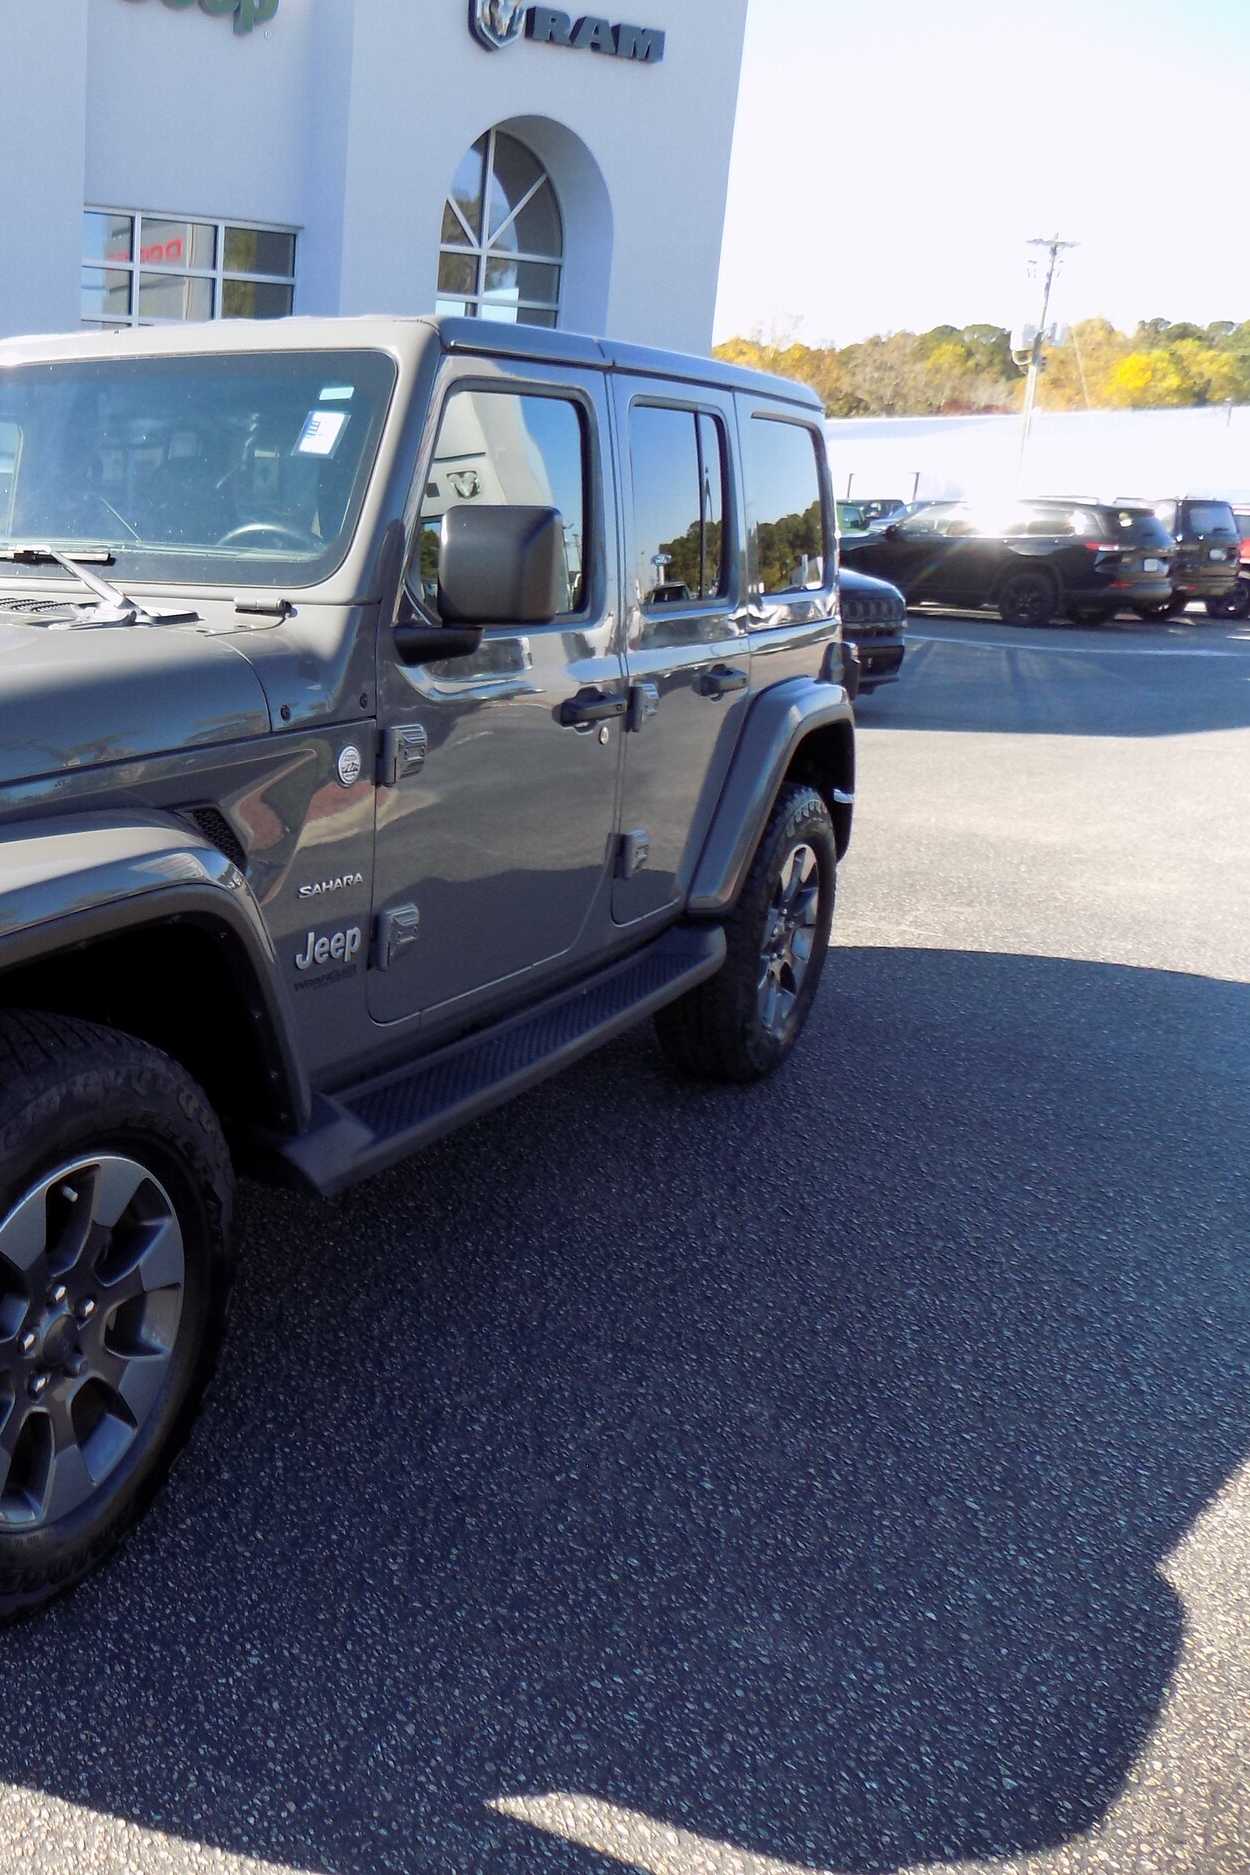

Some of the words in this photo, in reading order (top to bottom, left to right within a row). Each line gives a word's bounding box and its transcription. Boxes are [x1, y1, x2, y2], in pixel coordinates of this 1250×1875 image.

[525, 6, 665, 62] RAM
[299, 872, 363, 899] SAHARA
[296, 926, 362, 970] Jeep
